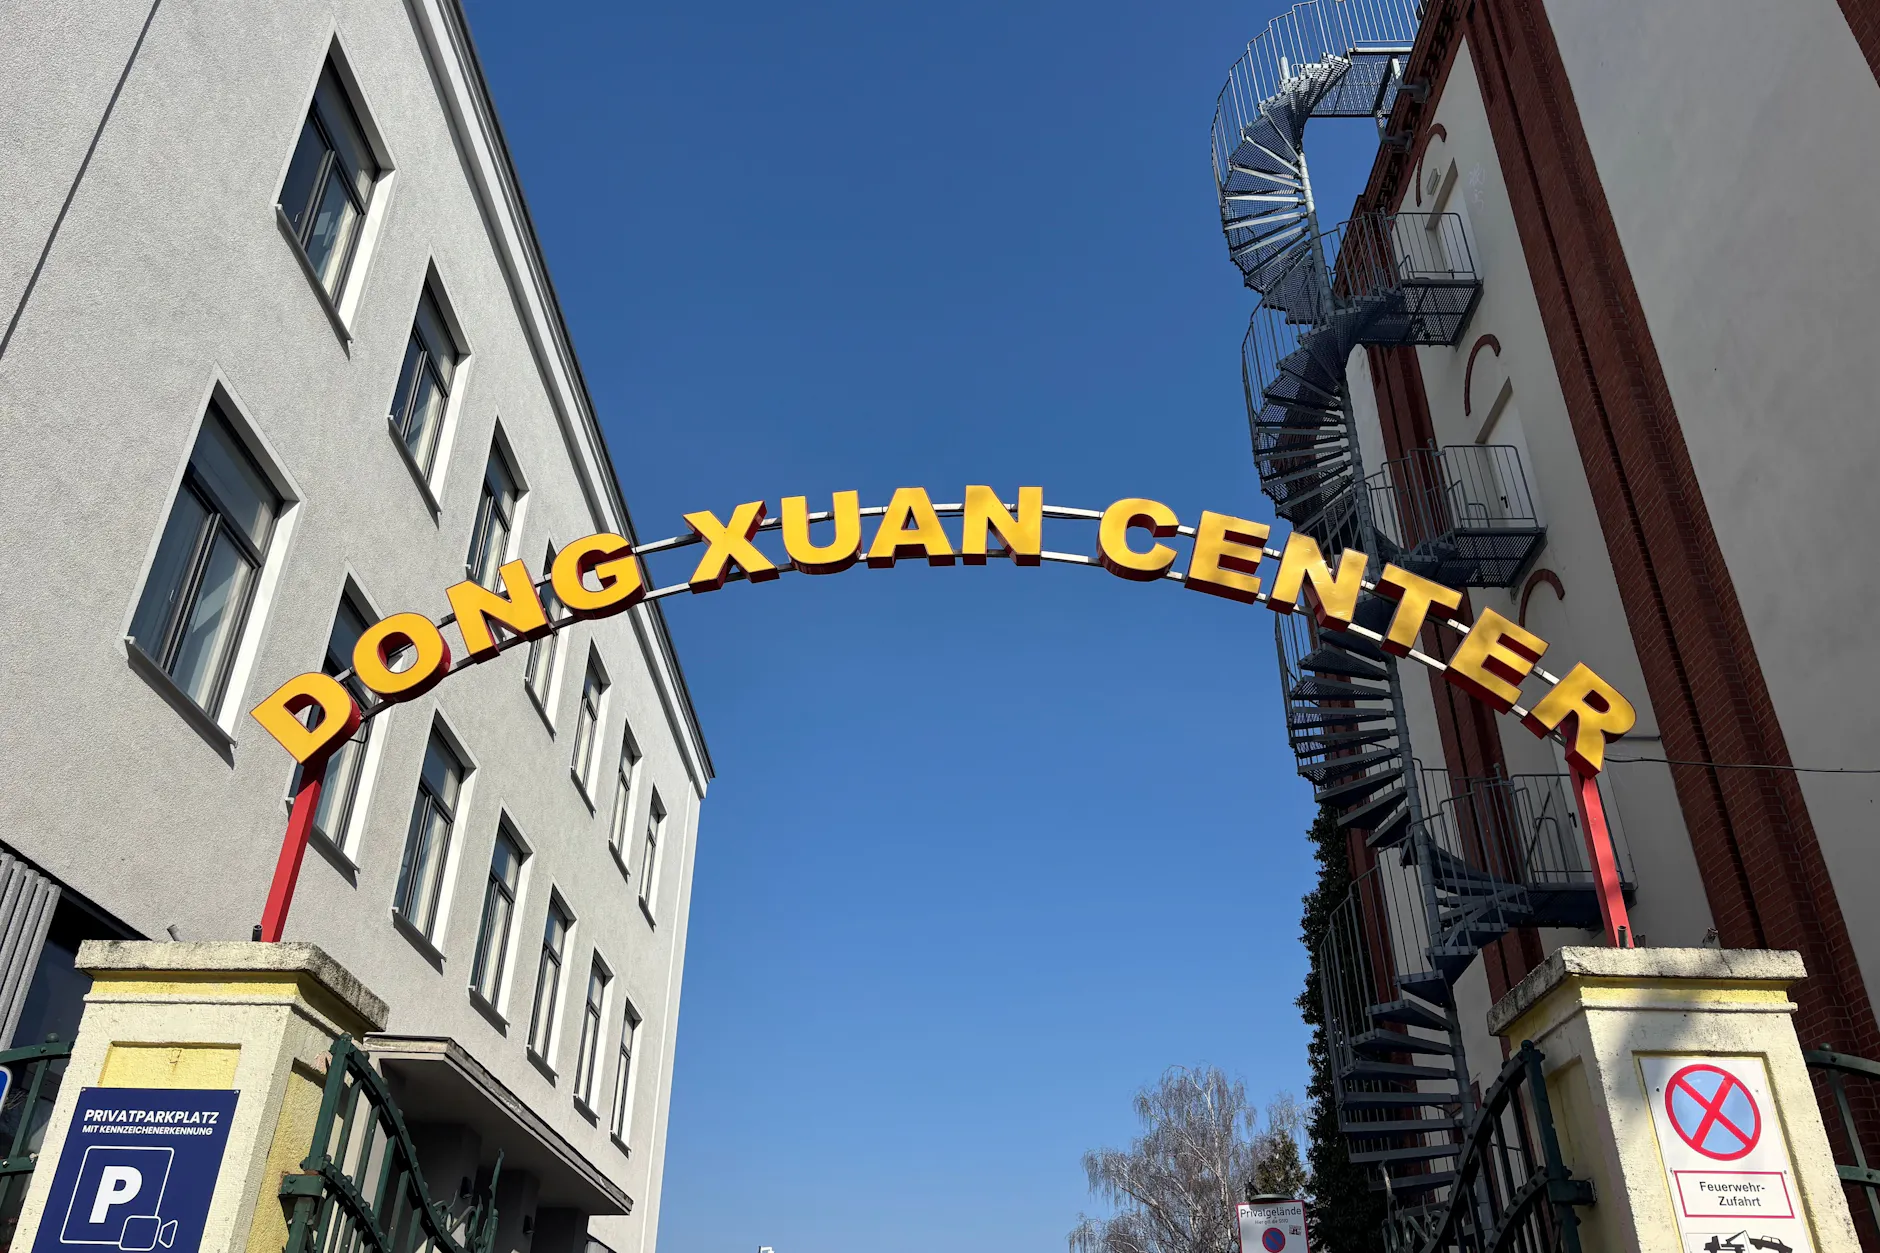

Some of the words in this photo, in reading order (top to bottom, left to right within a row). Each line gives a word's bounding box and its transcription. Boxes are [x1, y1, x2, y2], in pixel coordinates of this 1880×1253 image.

[250, 532, 646, 765] DONG
[684, 485, 1043, 583] XUAN
[1097, 497, 1637, 779] CENTER
[84, 1109, 220, 1124] PRIVATPARKPLATZ
[82, 1125, 99, 1134] MIT
[100, 1125, 213, 1136] KENNZEICHENERKENNUNG
[1699, 1181, 1766, 1193] Feuerwehr-
[88, 1165, 143, 1224] P
[1718, 1195, 1761, 1207] Zufahrt
[1240, 1206, 1302, 1219] Privatgelände
